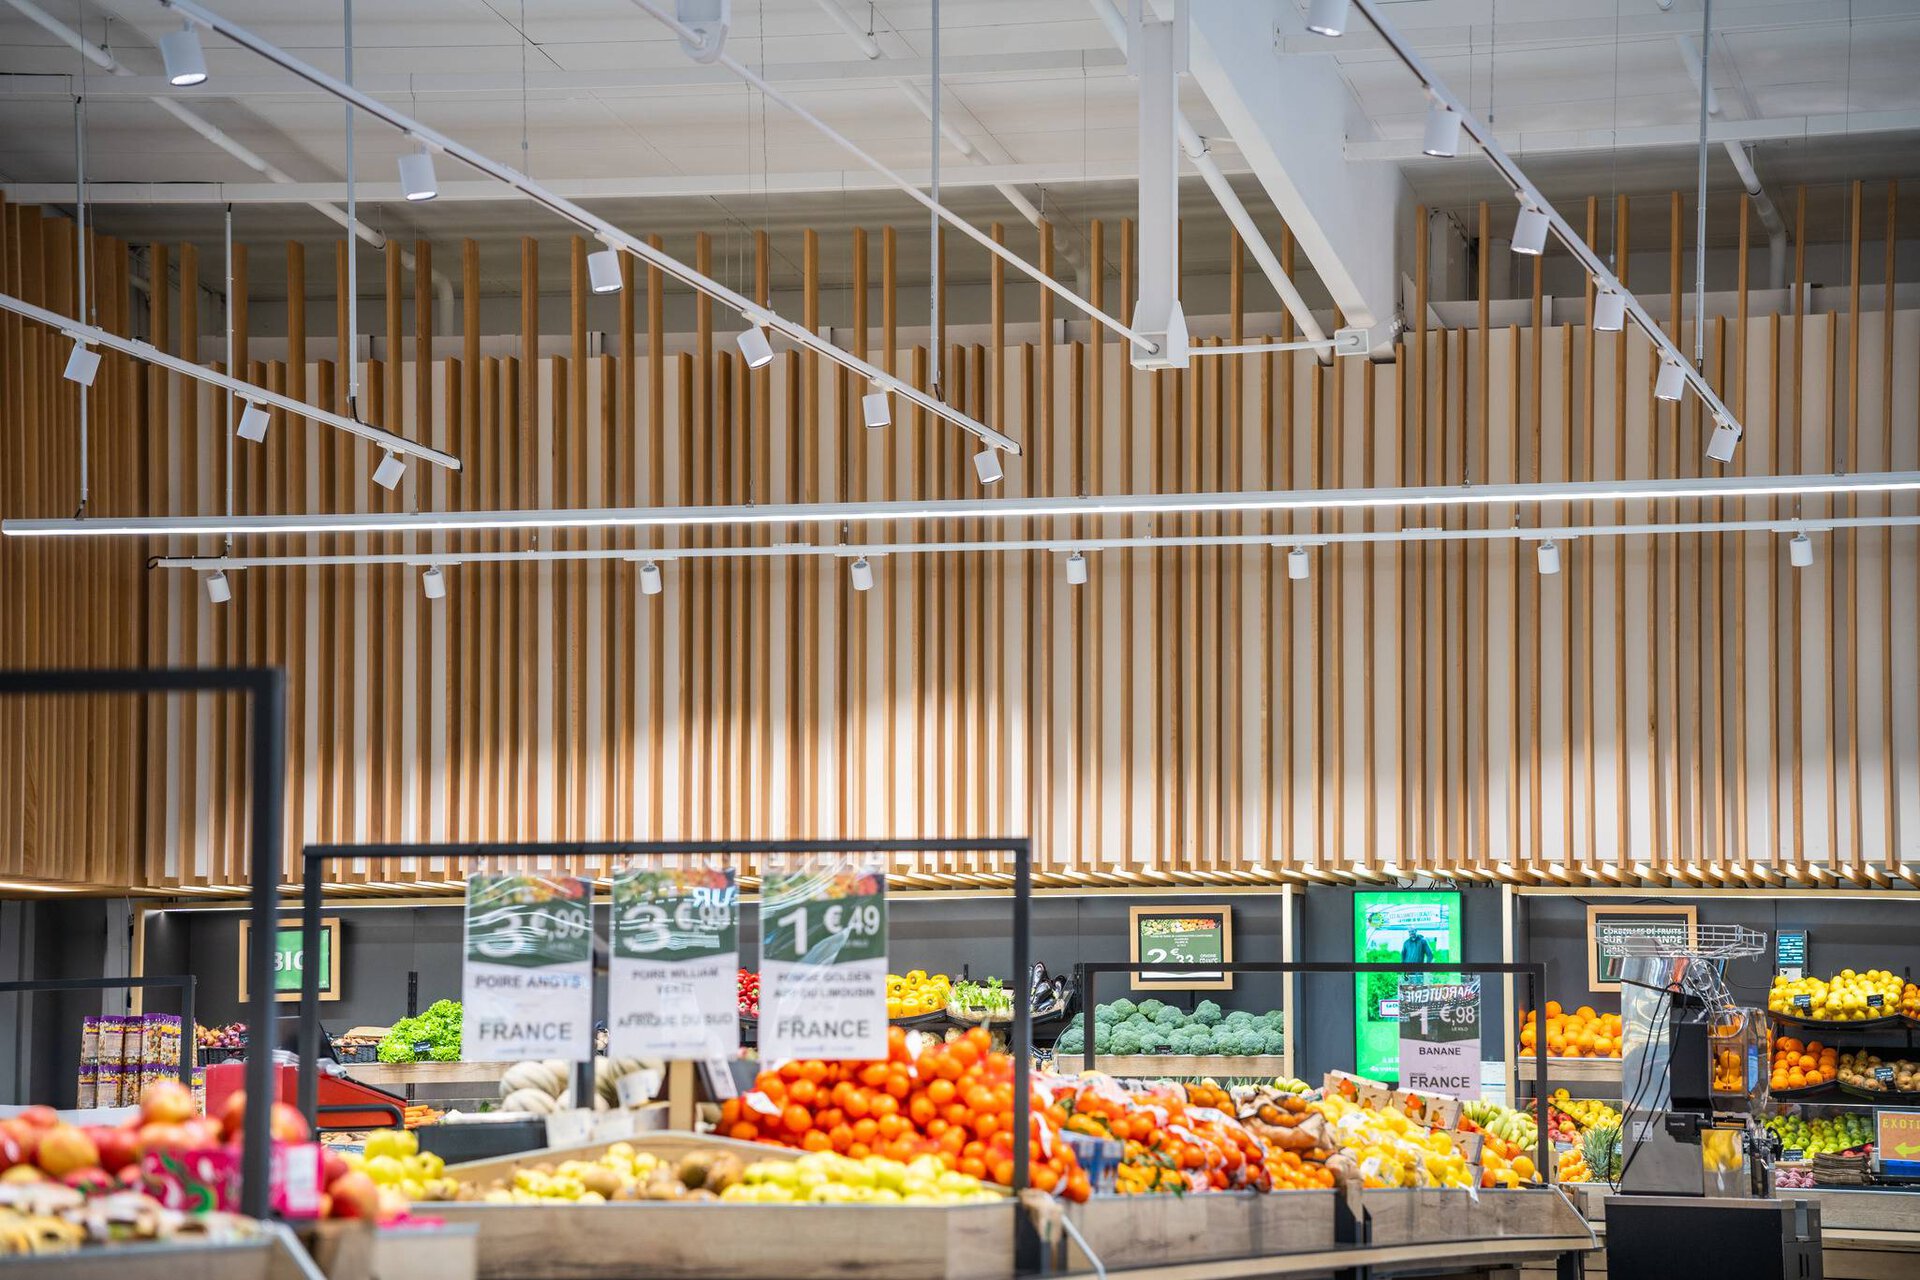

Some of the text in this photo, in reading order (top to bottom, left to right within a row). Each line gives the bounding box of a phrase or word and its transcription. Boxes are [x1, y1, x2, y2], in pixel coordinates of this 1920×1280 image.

[777, 906, 808, 955] 1
[1603, 936, 1623, 944] SUR
[670, 967, 719, 978] WILLIAM
[822, 972, 872, 982] GOLDEN
[475, 975, 522, 989] POIRE
[705, 1013, 732, 1025] SUD
[1409, 1005, 1429, 1035] 1
[478, 1022, 573, 1041] FRANCE
[777, 1019, 870, 1039] FRANCE
[1418, 1047, 1461, 1056] BANANE
[1409, 1076, 1470, 1088] FRANCE
